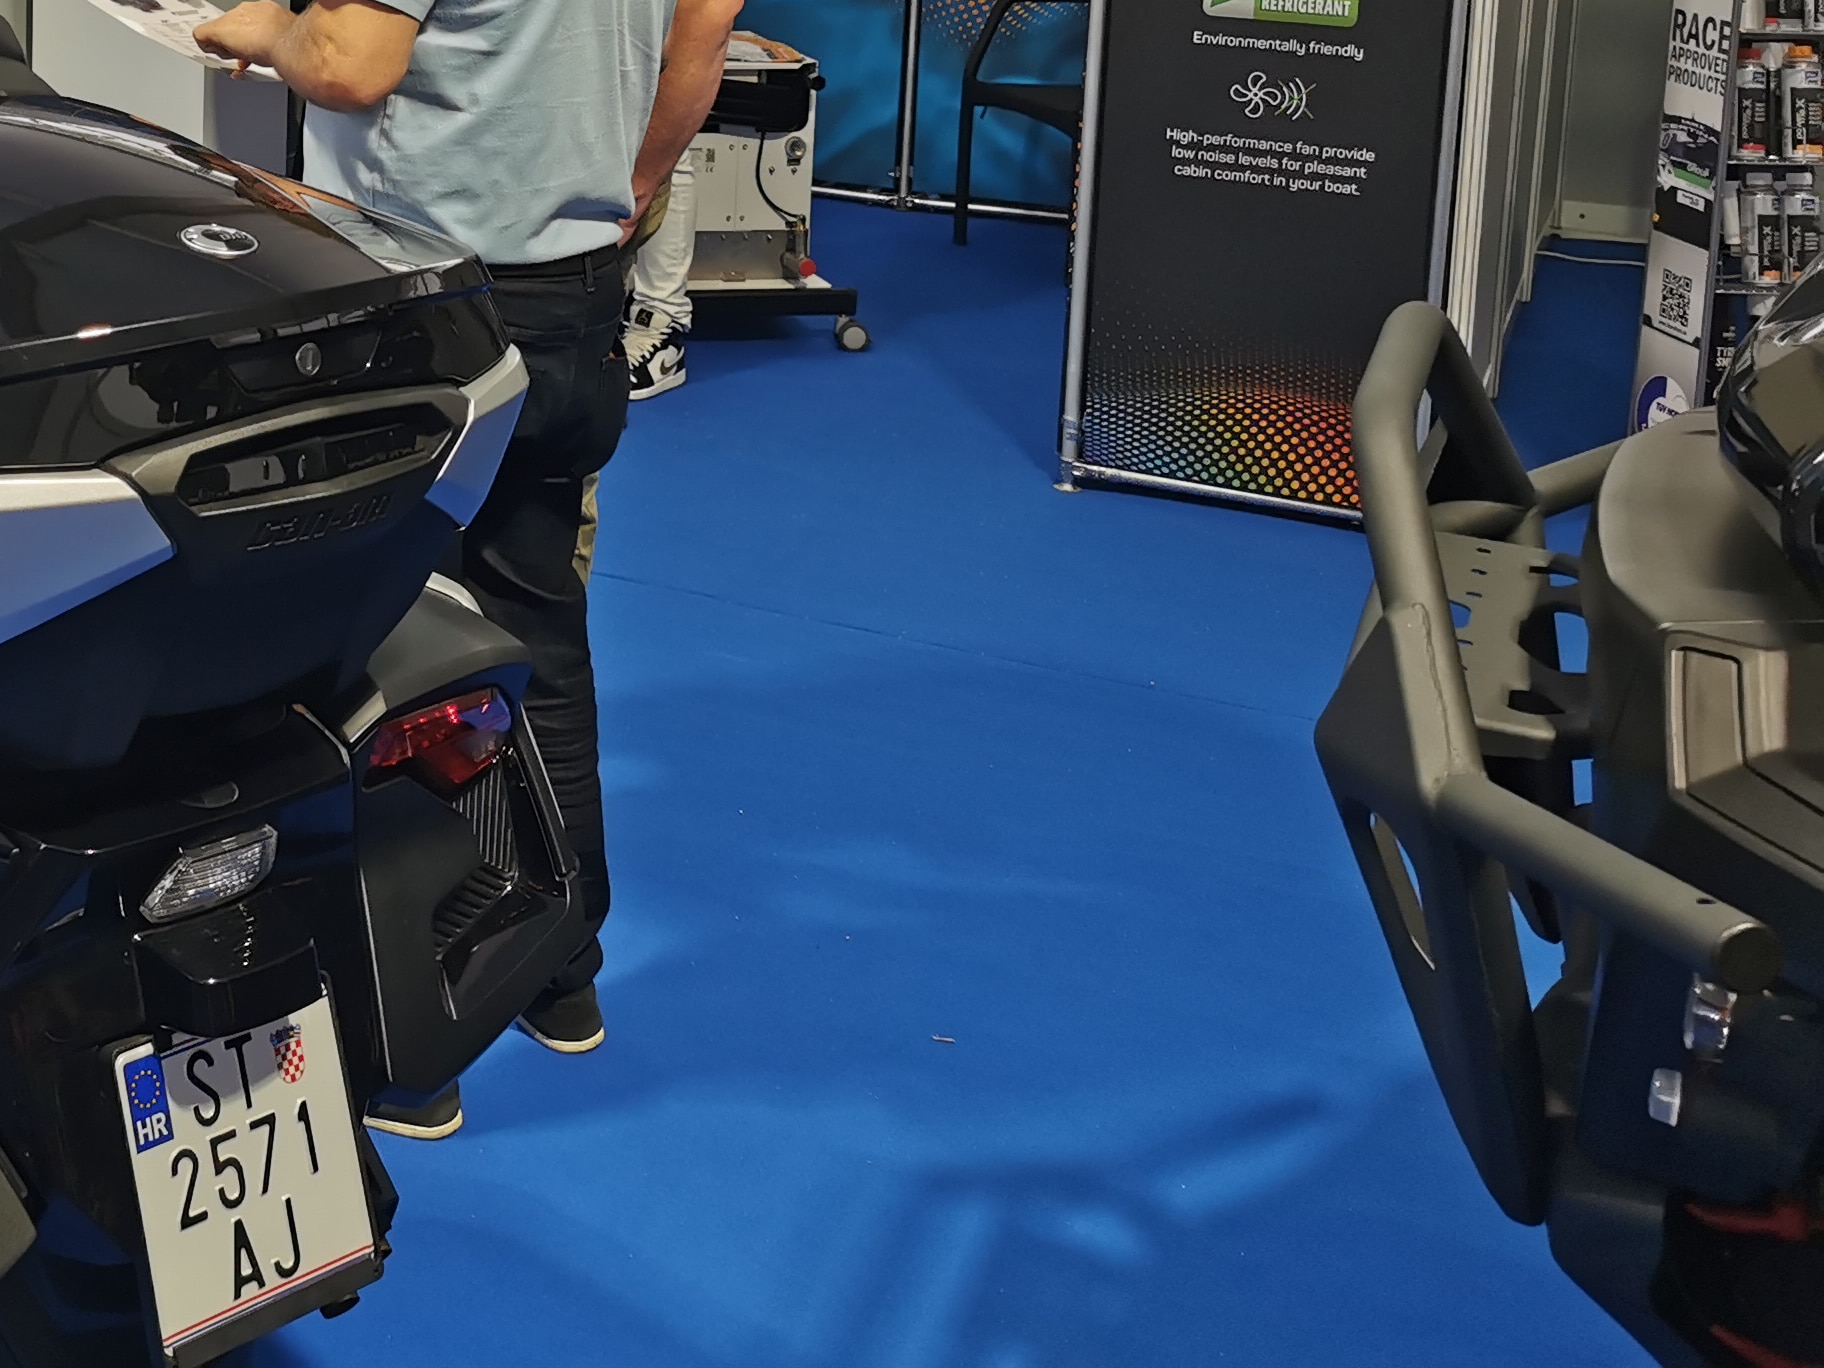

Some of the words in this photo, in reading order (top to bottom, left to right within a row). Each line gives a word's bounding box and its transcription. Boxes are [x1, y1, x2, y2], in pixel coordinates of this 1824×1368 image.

[1192, 30, 1306, 56] Environmentally
[1308, 39, 1365, 62] friendly
[1671, 7, 1733, 56] RACE
[1669, 44, 1728, 76] APPROVED
[1667, 63, 1727, 97] PRODUCTS
[1165, 127, 1293, 154] High-performance
[1296, 140, 1320, 156] fan
[1321, 146, 1376, 162] provide
[1171, 145, 1196, 159] low
[1197, 149, 1236, 164] noise
[1238, 151, 1279, 169] levels
[1282, 156, 1302, 172] for
[1304, 160, 1368, 179] pleasant
[1173, 164, 1212, 178] cabin
[1213, 169, 1271, 186] comfort
[1273, 173, 1286, 187] in
[1288, 178, 1323, 192] your
[1324, 179, 1361, 196] boat.
[185, 1032, 253, 1127] ST
[136, 1111, 169, 1146] HR
[170, 1097, 320, 1232] 2571
[232, 1195, 302, 1302] AJ
